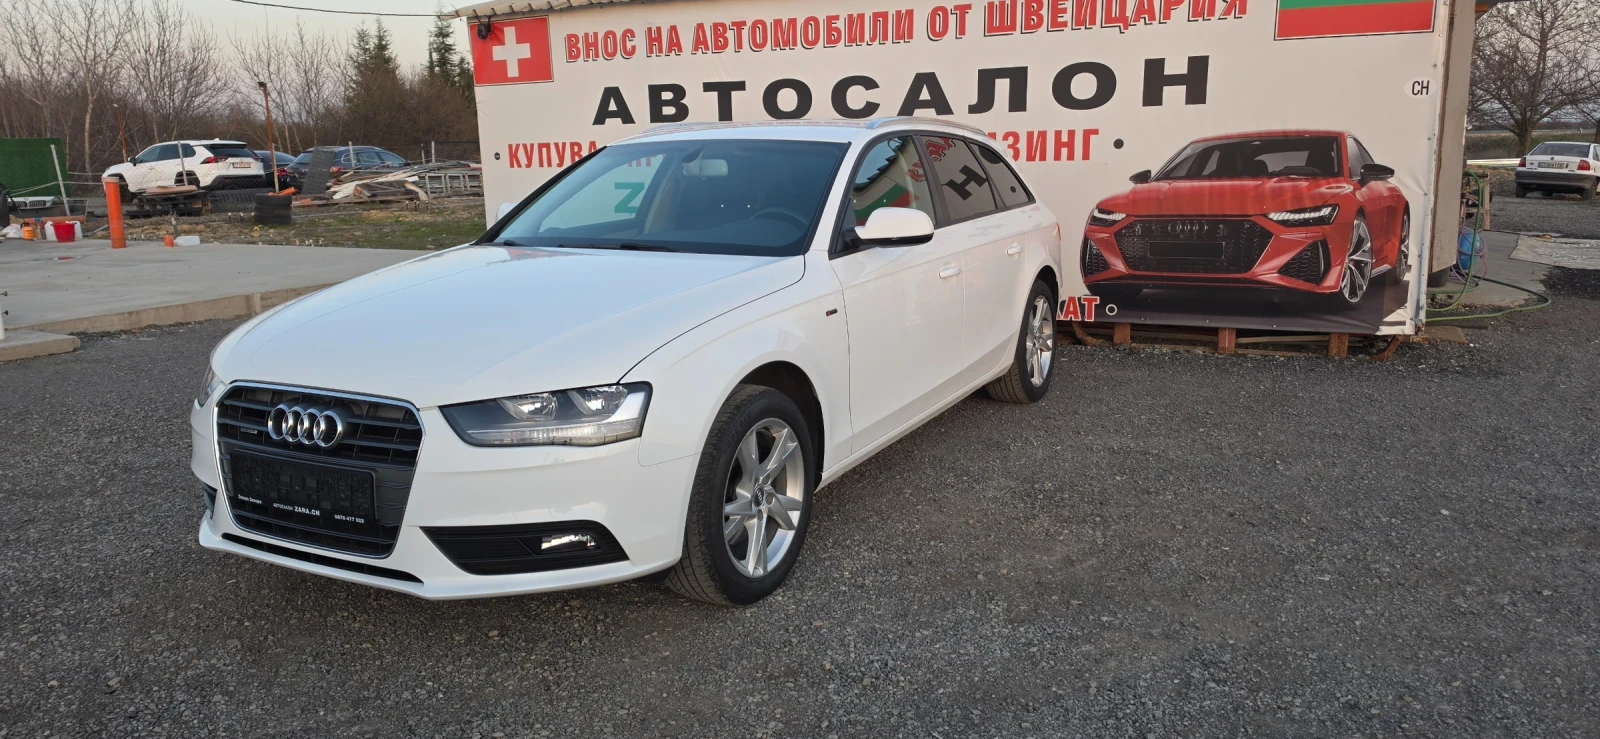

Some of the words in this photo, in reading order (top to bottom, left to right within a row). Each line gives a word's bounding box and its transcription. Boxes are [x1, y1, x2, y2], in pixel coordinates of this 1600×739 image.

[565, 28, 637, 63] ВНОС
[645, 24, 683, 57] НА
[692, 8, 915, 54] АВТОМОБИЛИ
[926, 4, 972, 41] ОТ
[592, 55, 1210, 125] АВТОСАЛОН
[988, 128, 1100, 163] ЗИНГ
